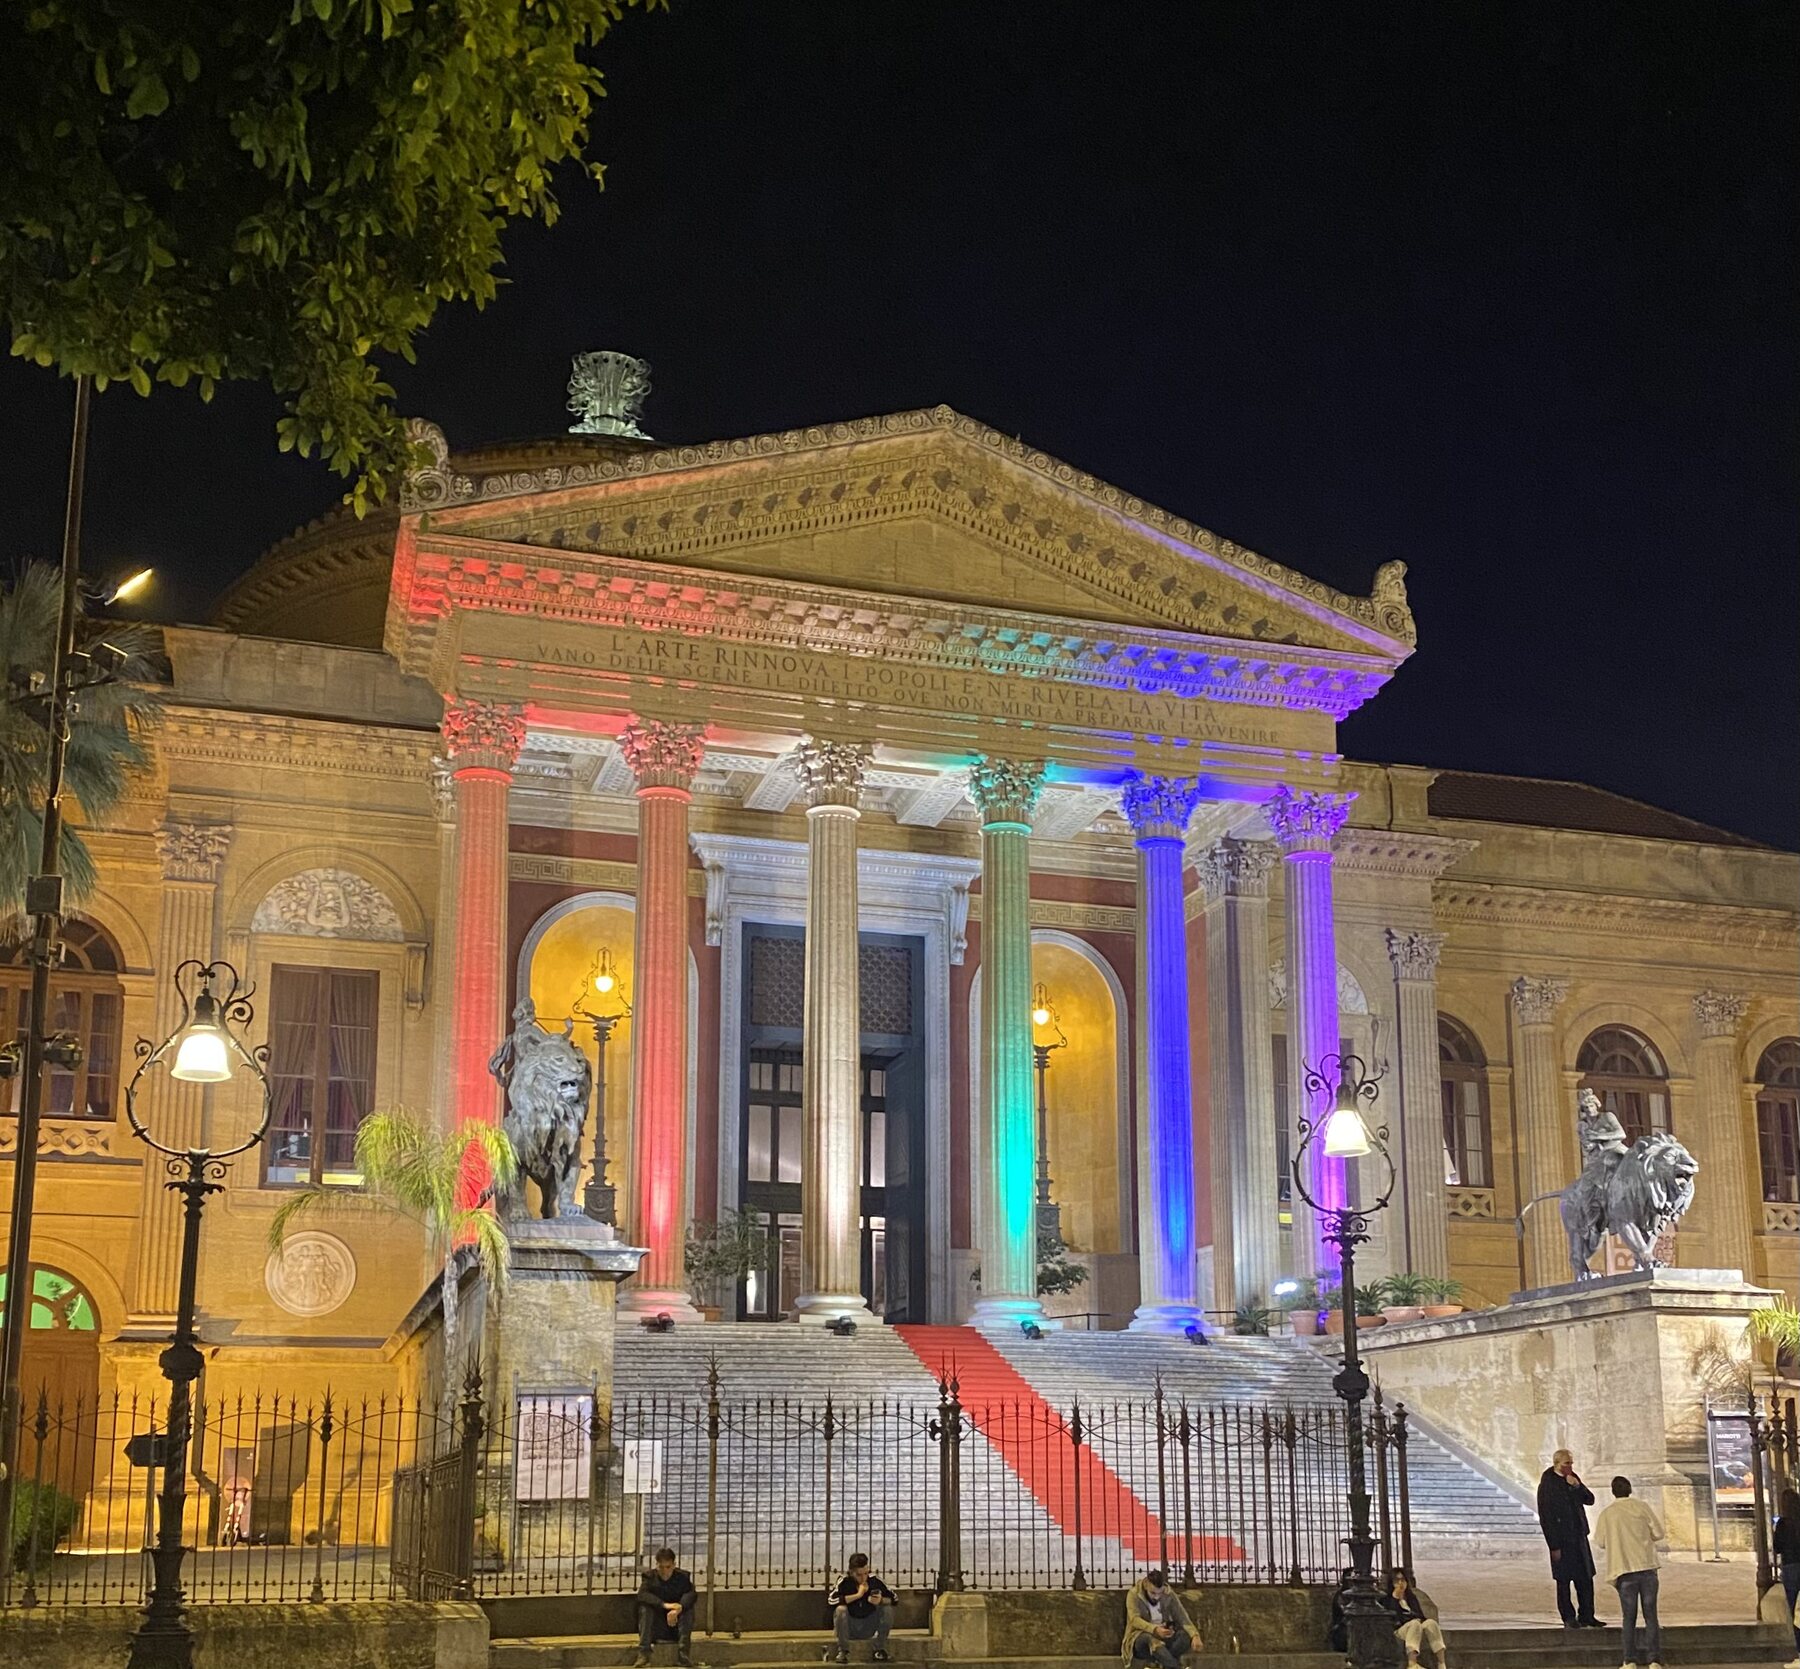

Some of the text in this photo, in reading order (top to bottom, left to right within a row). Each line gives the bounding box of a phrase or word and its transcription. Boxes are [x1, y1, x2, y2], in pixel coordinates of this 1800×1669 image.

[537, 643, 1279, 744] VANO DELLE SCENE IL DILETTO OVE NON MIRI A PREPARAR L'AVVENIRE
[611, 634, 1217, 723] L'ARTE RINNOVA I POPOLI E NE RIVELA LA VITA
